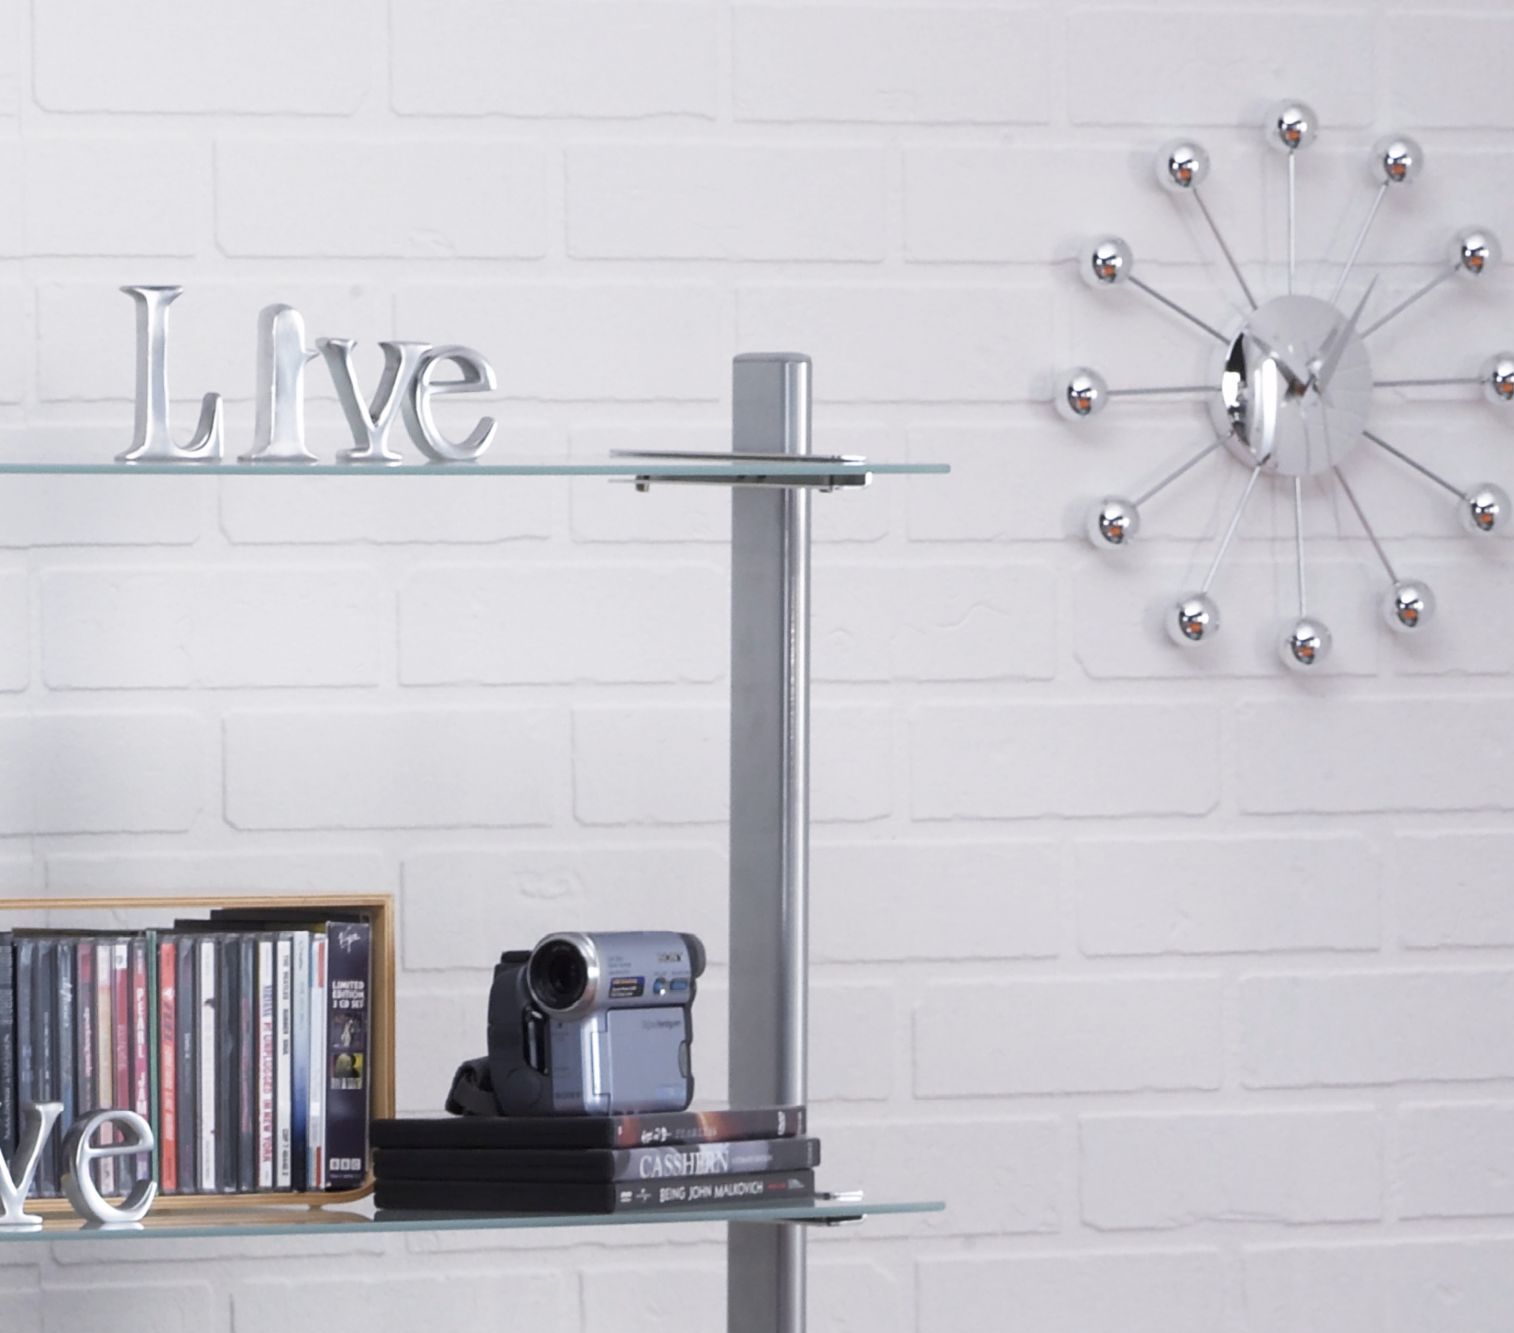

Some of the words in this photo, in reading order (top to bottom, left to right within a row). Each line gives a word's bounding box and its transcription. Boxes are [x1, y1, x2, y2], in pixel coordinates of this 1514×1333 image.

[659, 1186, 687, 1203] BEING
[688, 1184, 713, 1201] JOHN
[714, 1180, 764, 1199] MALKOVICH
